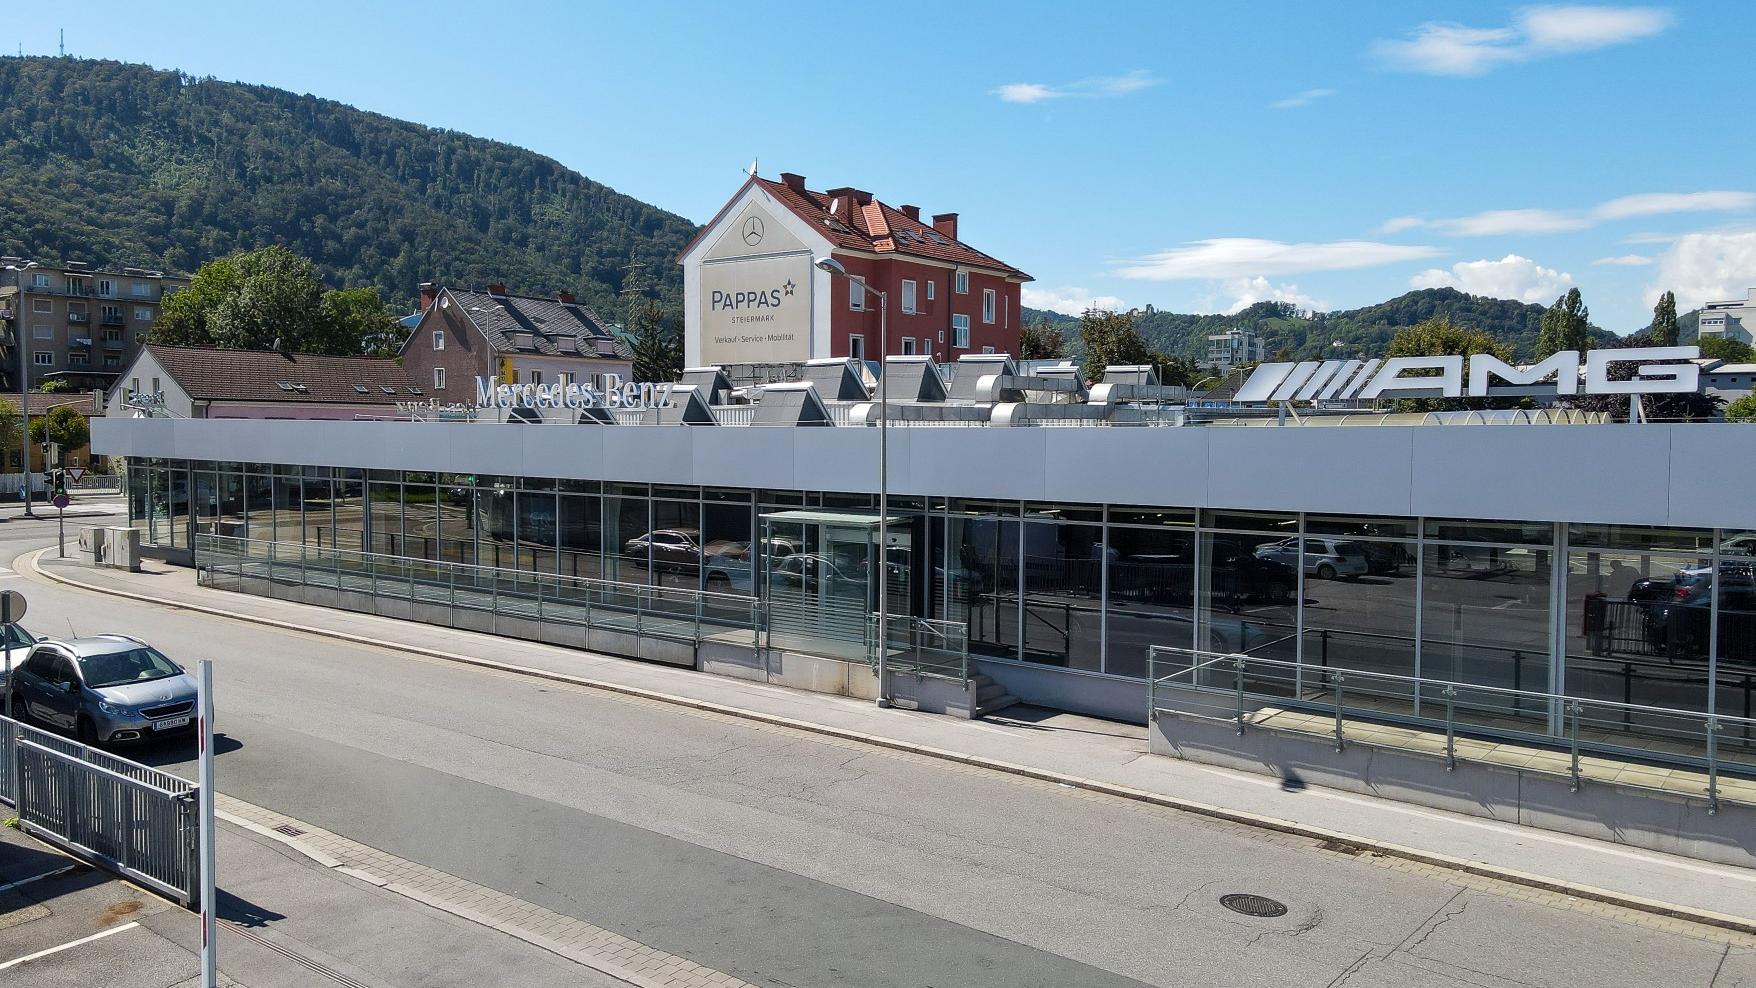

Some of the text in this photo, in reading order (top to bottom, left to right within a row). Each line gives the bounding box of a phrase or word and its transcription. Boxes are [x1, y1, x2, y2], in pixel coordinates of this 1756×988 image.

[711, 289, 781, 311] PAPPAS
[731, 314, 775, 324] STEIERMARK
[714, 335, 737, 344] Verkauf
[741, 335, 763, 343] Service
[475, 373, 674, 409] Mercedes-Benz
